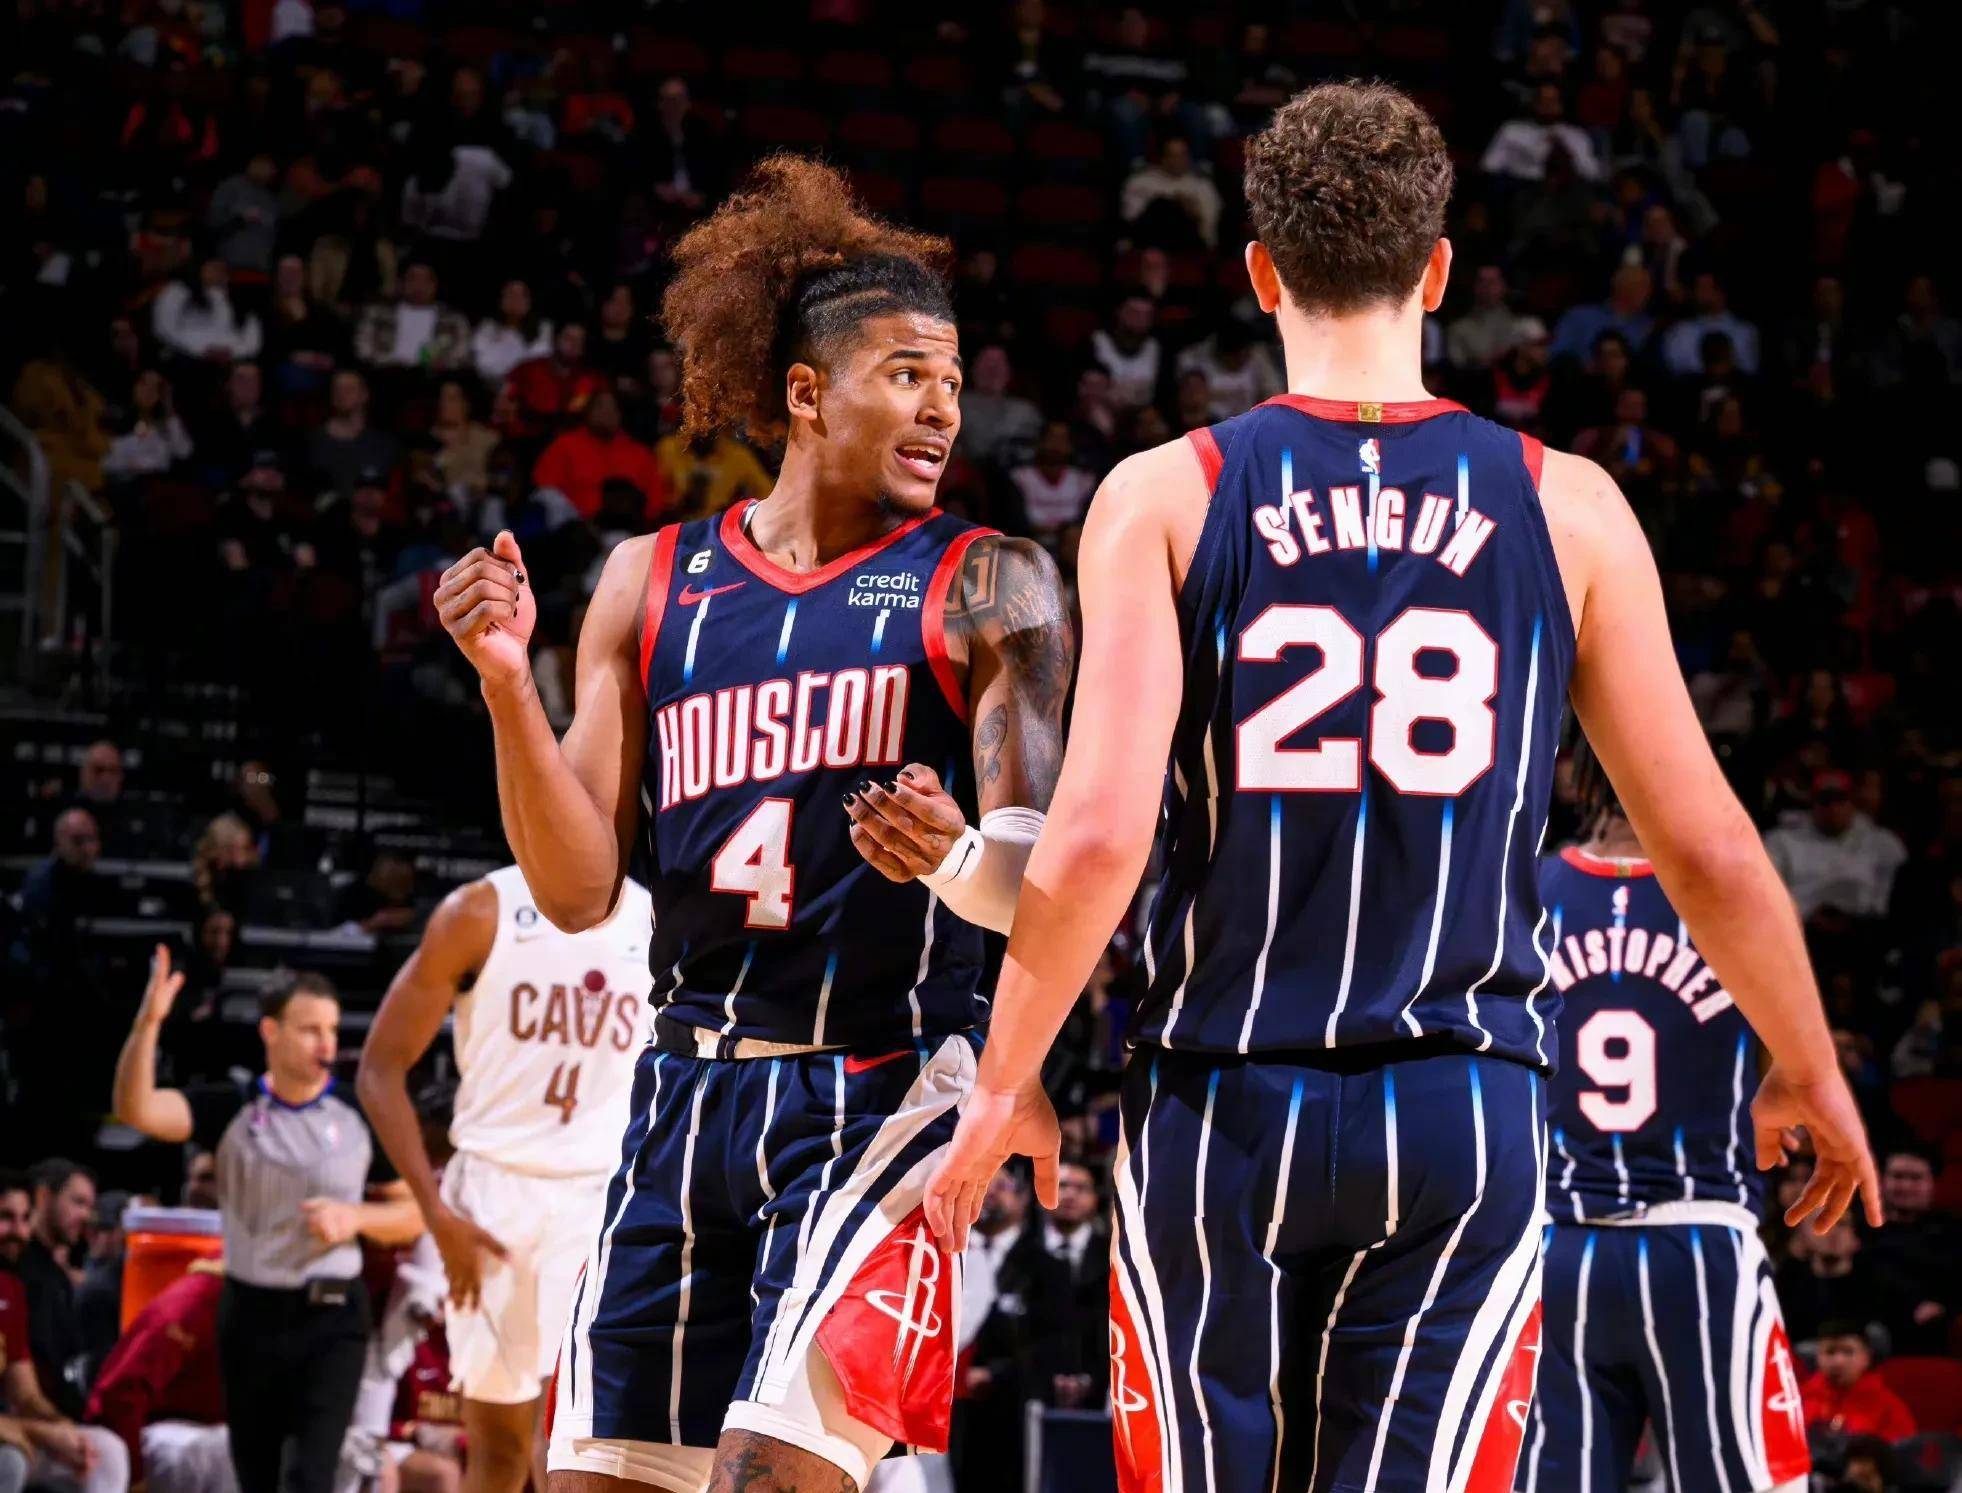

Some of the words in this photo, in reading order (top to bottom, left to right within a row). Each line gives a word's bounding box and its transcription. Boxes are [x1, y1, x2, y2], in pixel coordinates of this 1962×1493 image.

[687, 549, 712, 574] 6
[1252, 486, 1497, 578] SENGUN
[848, 588, 920, 609] karma
[856, 573, 919, 591] credit
[1236, 603, 1499, 797] 28
[710, 797, 795, 930] 4
[511, 980, 639, 1052] CAVS
[543, 1061, 581, 1125] 4
[1577, 1009, 1657, 1133] 9
